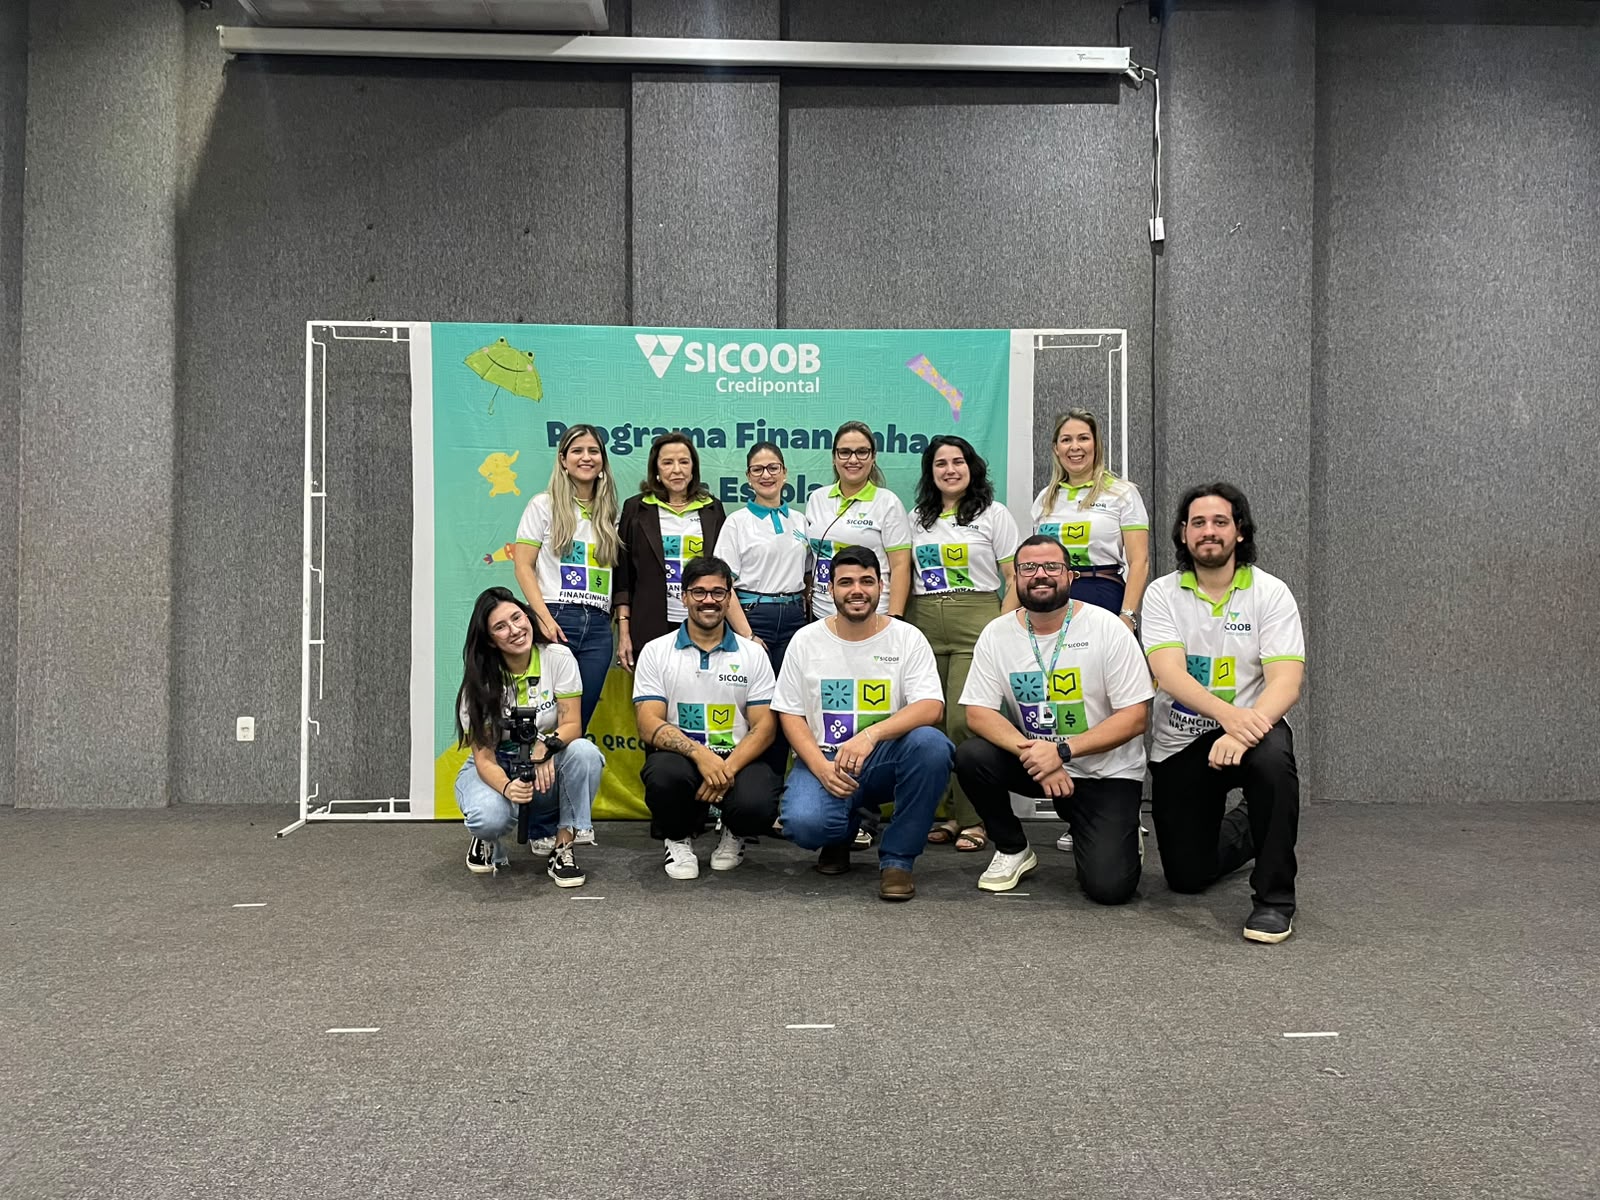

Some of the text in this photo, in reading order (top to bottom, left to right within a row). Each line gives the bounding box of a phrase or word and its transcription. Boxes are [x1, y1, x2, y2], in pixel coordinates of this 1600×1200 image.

[684, 341, 821, 374] SICOOB
[715, 377, 820, 396] Credipontal
[546, 421, 727, 455] Pgrama
[559, 591, 609, 603] FINANCINHAS
[1224, 622, 1252, 632] COOB
[718, 673, 748, 684] SICOOB
[1169, 710, 1221, 728] FINANCINH
[602, 733, 646, 751] QRCO
